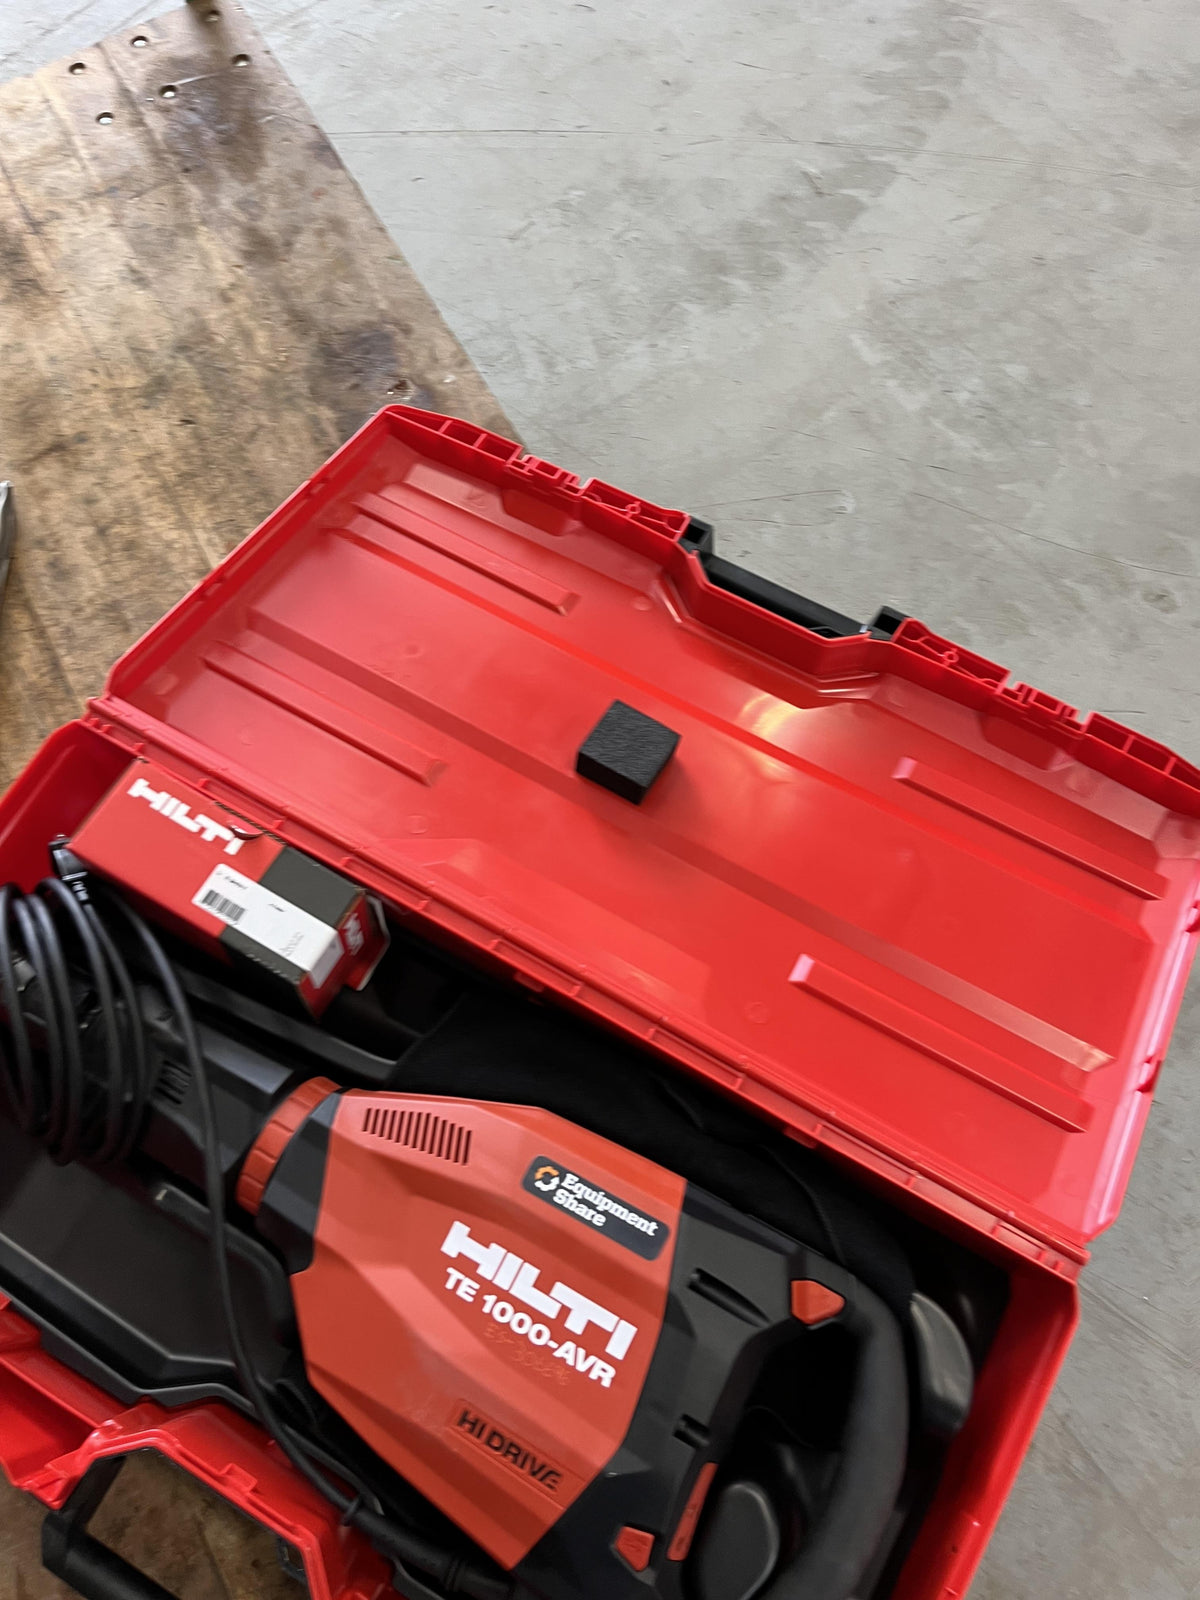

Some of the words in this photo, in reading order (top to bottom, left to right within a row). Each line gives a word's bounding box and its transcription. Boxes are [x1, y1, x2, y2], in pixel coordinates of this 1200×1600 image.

[127, 778, 245, 856] HILTI
[553, 1188, 607, 1227] Share
[561, 1173, 659, 1236] Equipment
[441, 1220, 638, 1361] HILTI
[445, 1267, 480, 1302] TE
[482, 1294, 617, 1388] 1000-AVR
